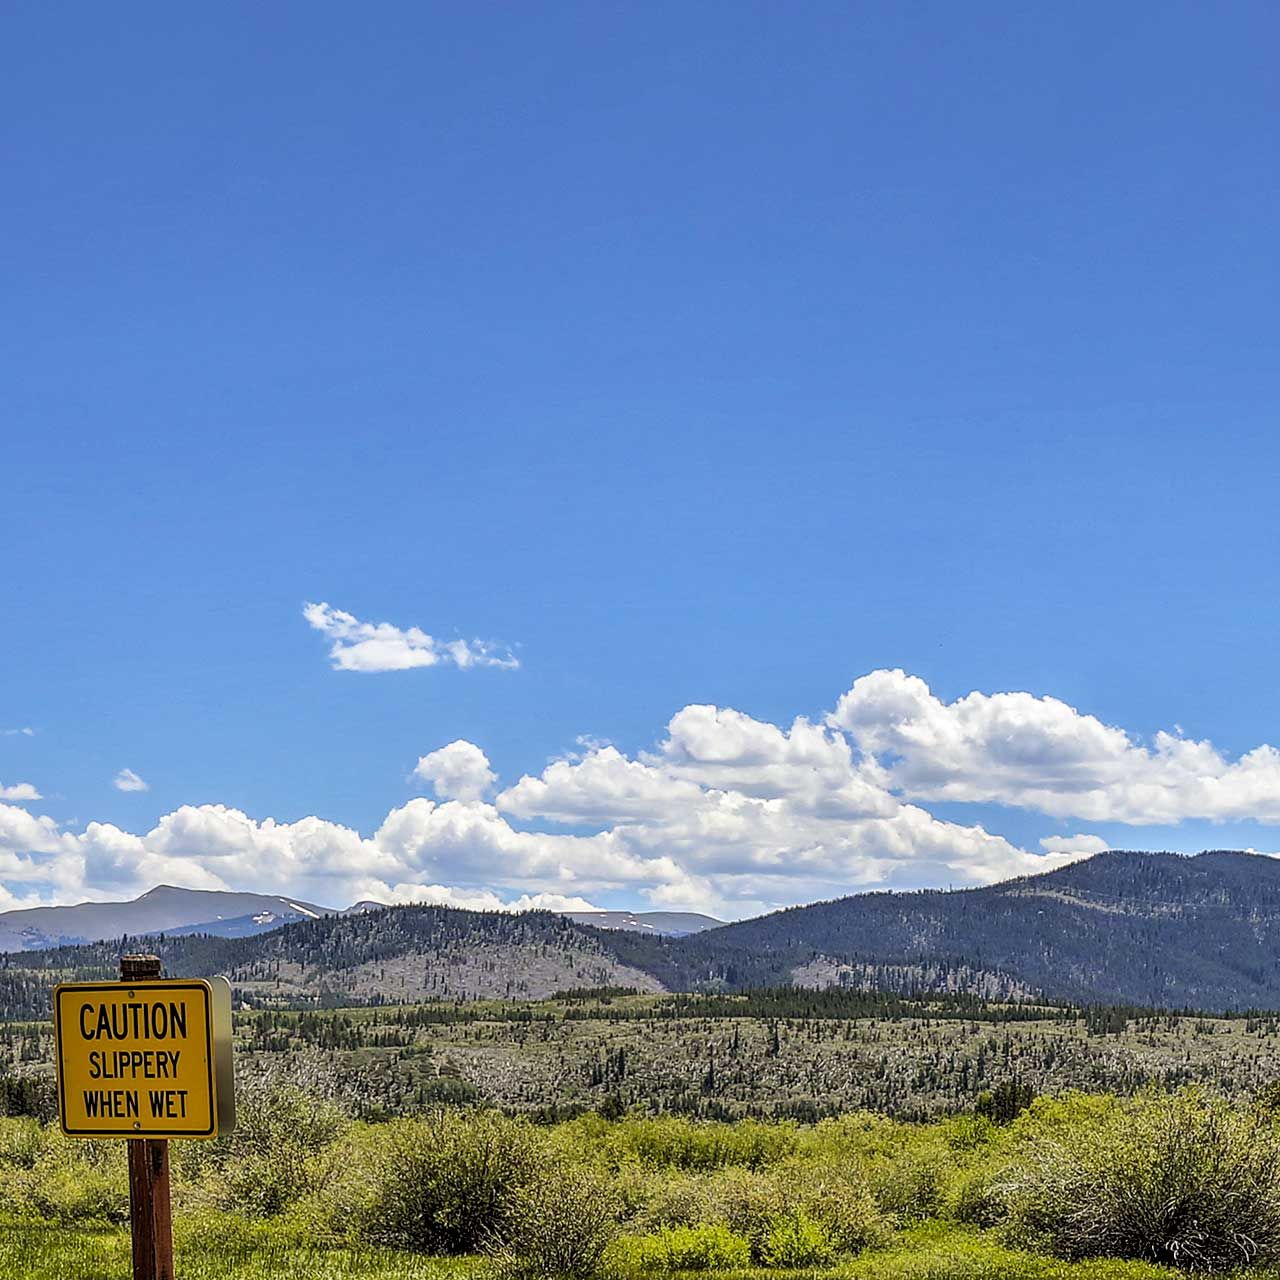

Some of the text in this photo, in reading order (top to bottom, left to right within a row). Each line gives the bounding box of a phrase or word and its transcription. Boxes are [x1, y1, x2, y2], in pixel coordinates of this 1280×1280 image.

[80, 1002, 187, 1040] CAUTION
[89, 1051, 180, 1078] SLIPPERY
[84, 1091, 188, 1118] WHEN WET
